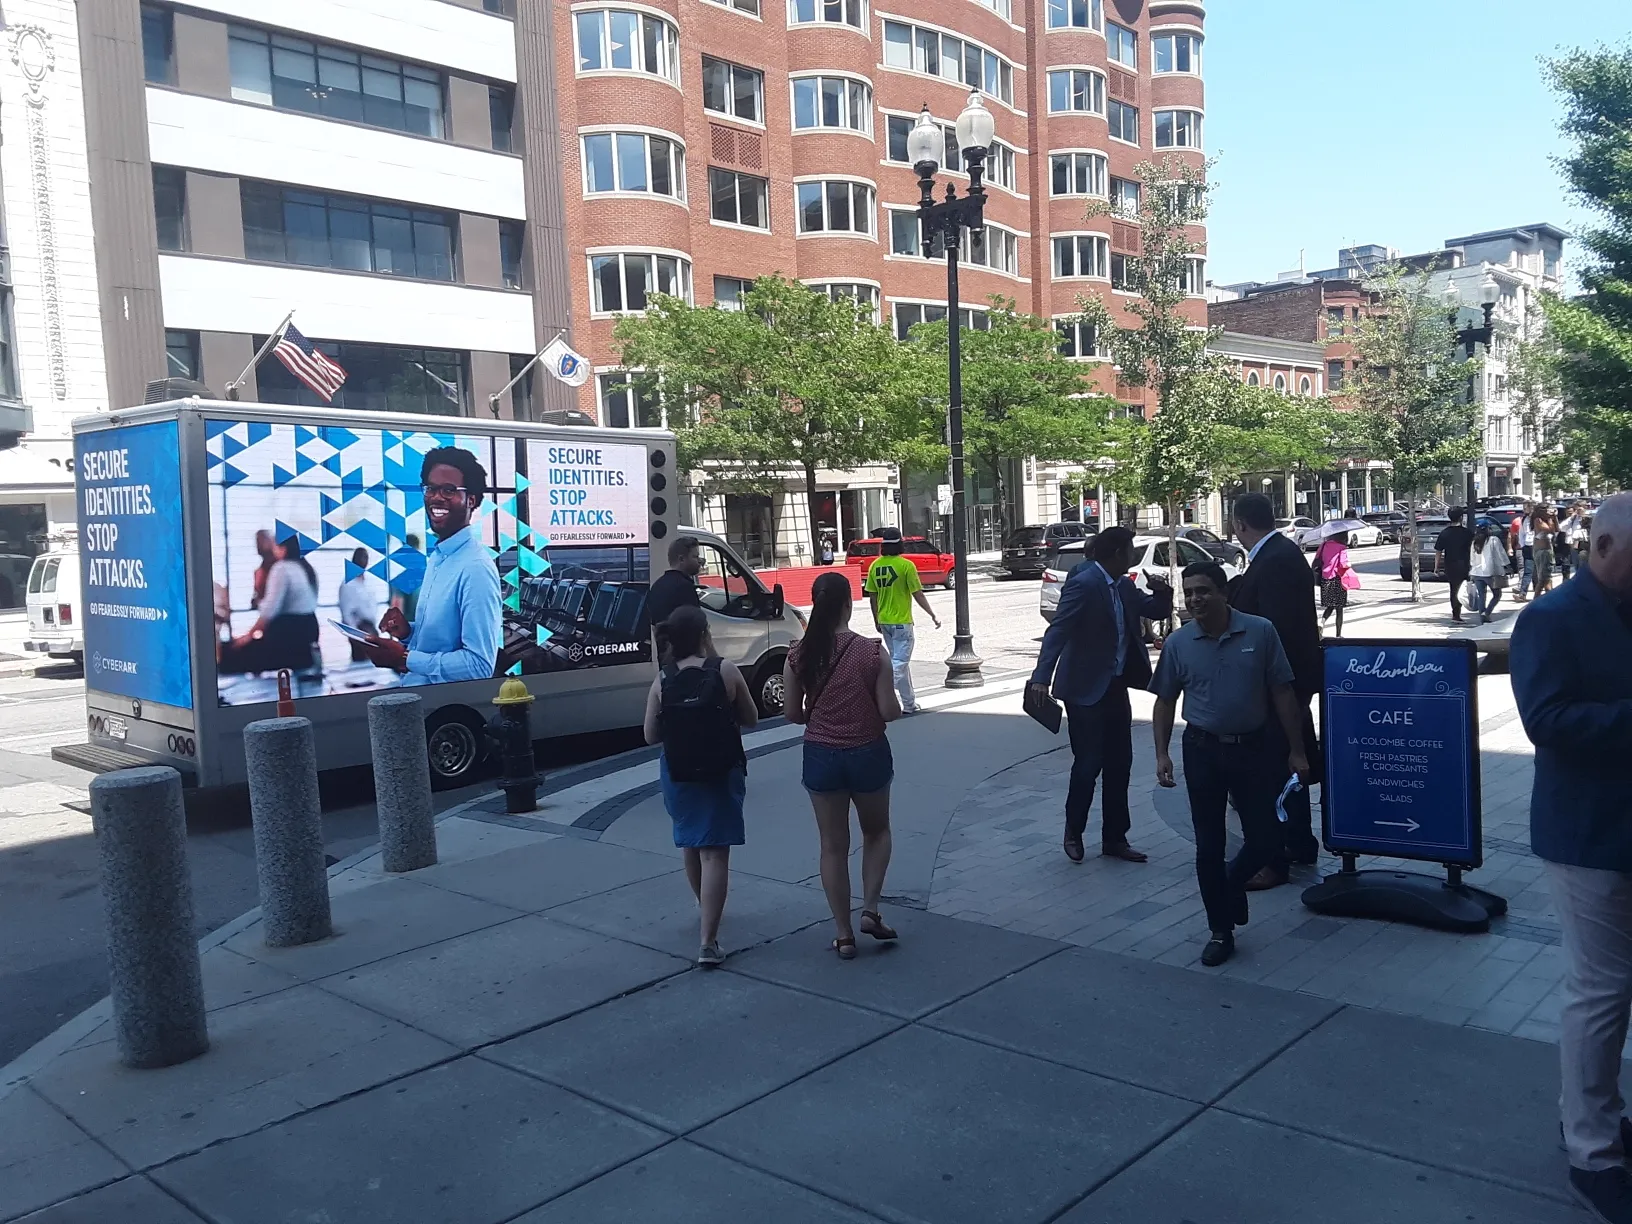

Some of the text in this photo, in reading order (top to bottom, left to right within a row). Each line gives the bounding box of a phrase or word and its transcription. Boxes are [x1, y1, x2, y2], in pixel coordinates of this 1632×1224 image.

[83, 449, 130, 481] SECURE
[548, 447, 603, 466] SECURE
[549, 468, 628, 487] IDENTITIES.
[85, 484, 156, 516] IDENTITIES.
[549, 489, 587, 506] STOP
[550, 509, 617, 526] ATTACKS.
[86, 523, 118, 552] STOP
[550, 532, 625, 541] GO FEARLESSLY FORWARD
[89, 558, 148, 589] ATTACKS.
[90, 602, 157, 621] GO FEARLESSLY FORWARD
[584, 641, 640, 656] CYBERARK
[102, 657, 138, 675] CYBERARK
[1345, 649, 1445, 679] Rochambeau
[1368, 707, 1414, 726] CAFÉ
[1347, 736, 1444, 749] LA COLOMBE COFFEE
[1359, 752, 1428, 764] FRESH PASTRIES
[1363, 762, 1428, 774] & CROISSANTS
[1366, 777, 1425, 789] SANDWICHES
[1379, 793, 1413, 804] SALADS
